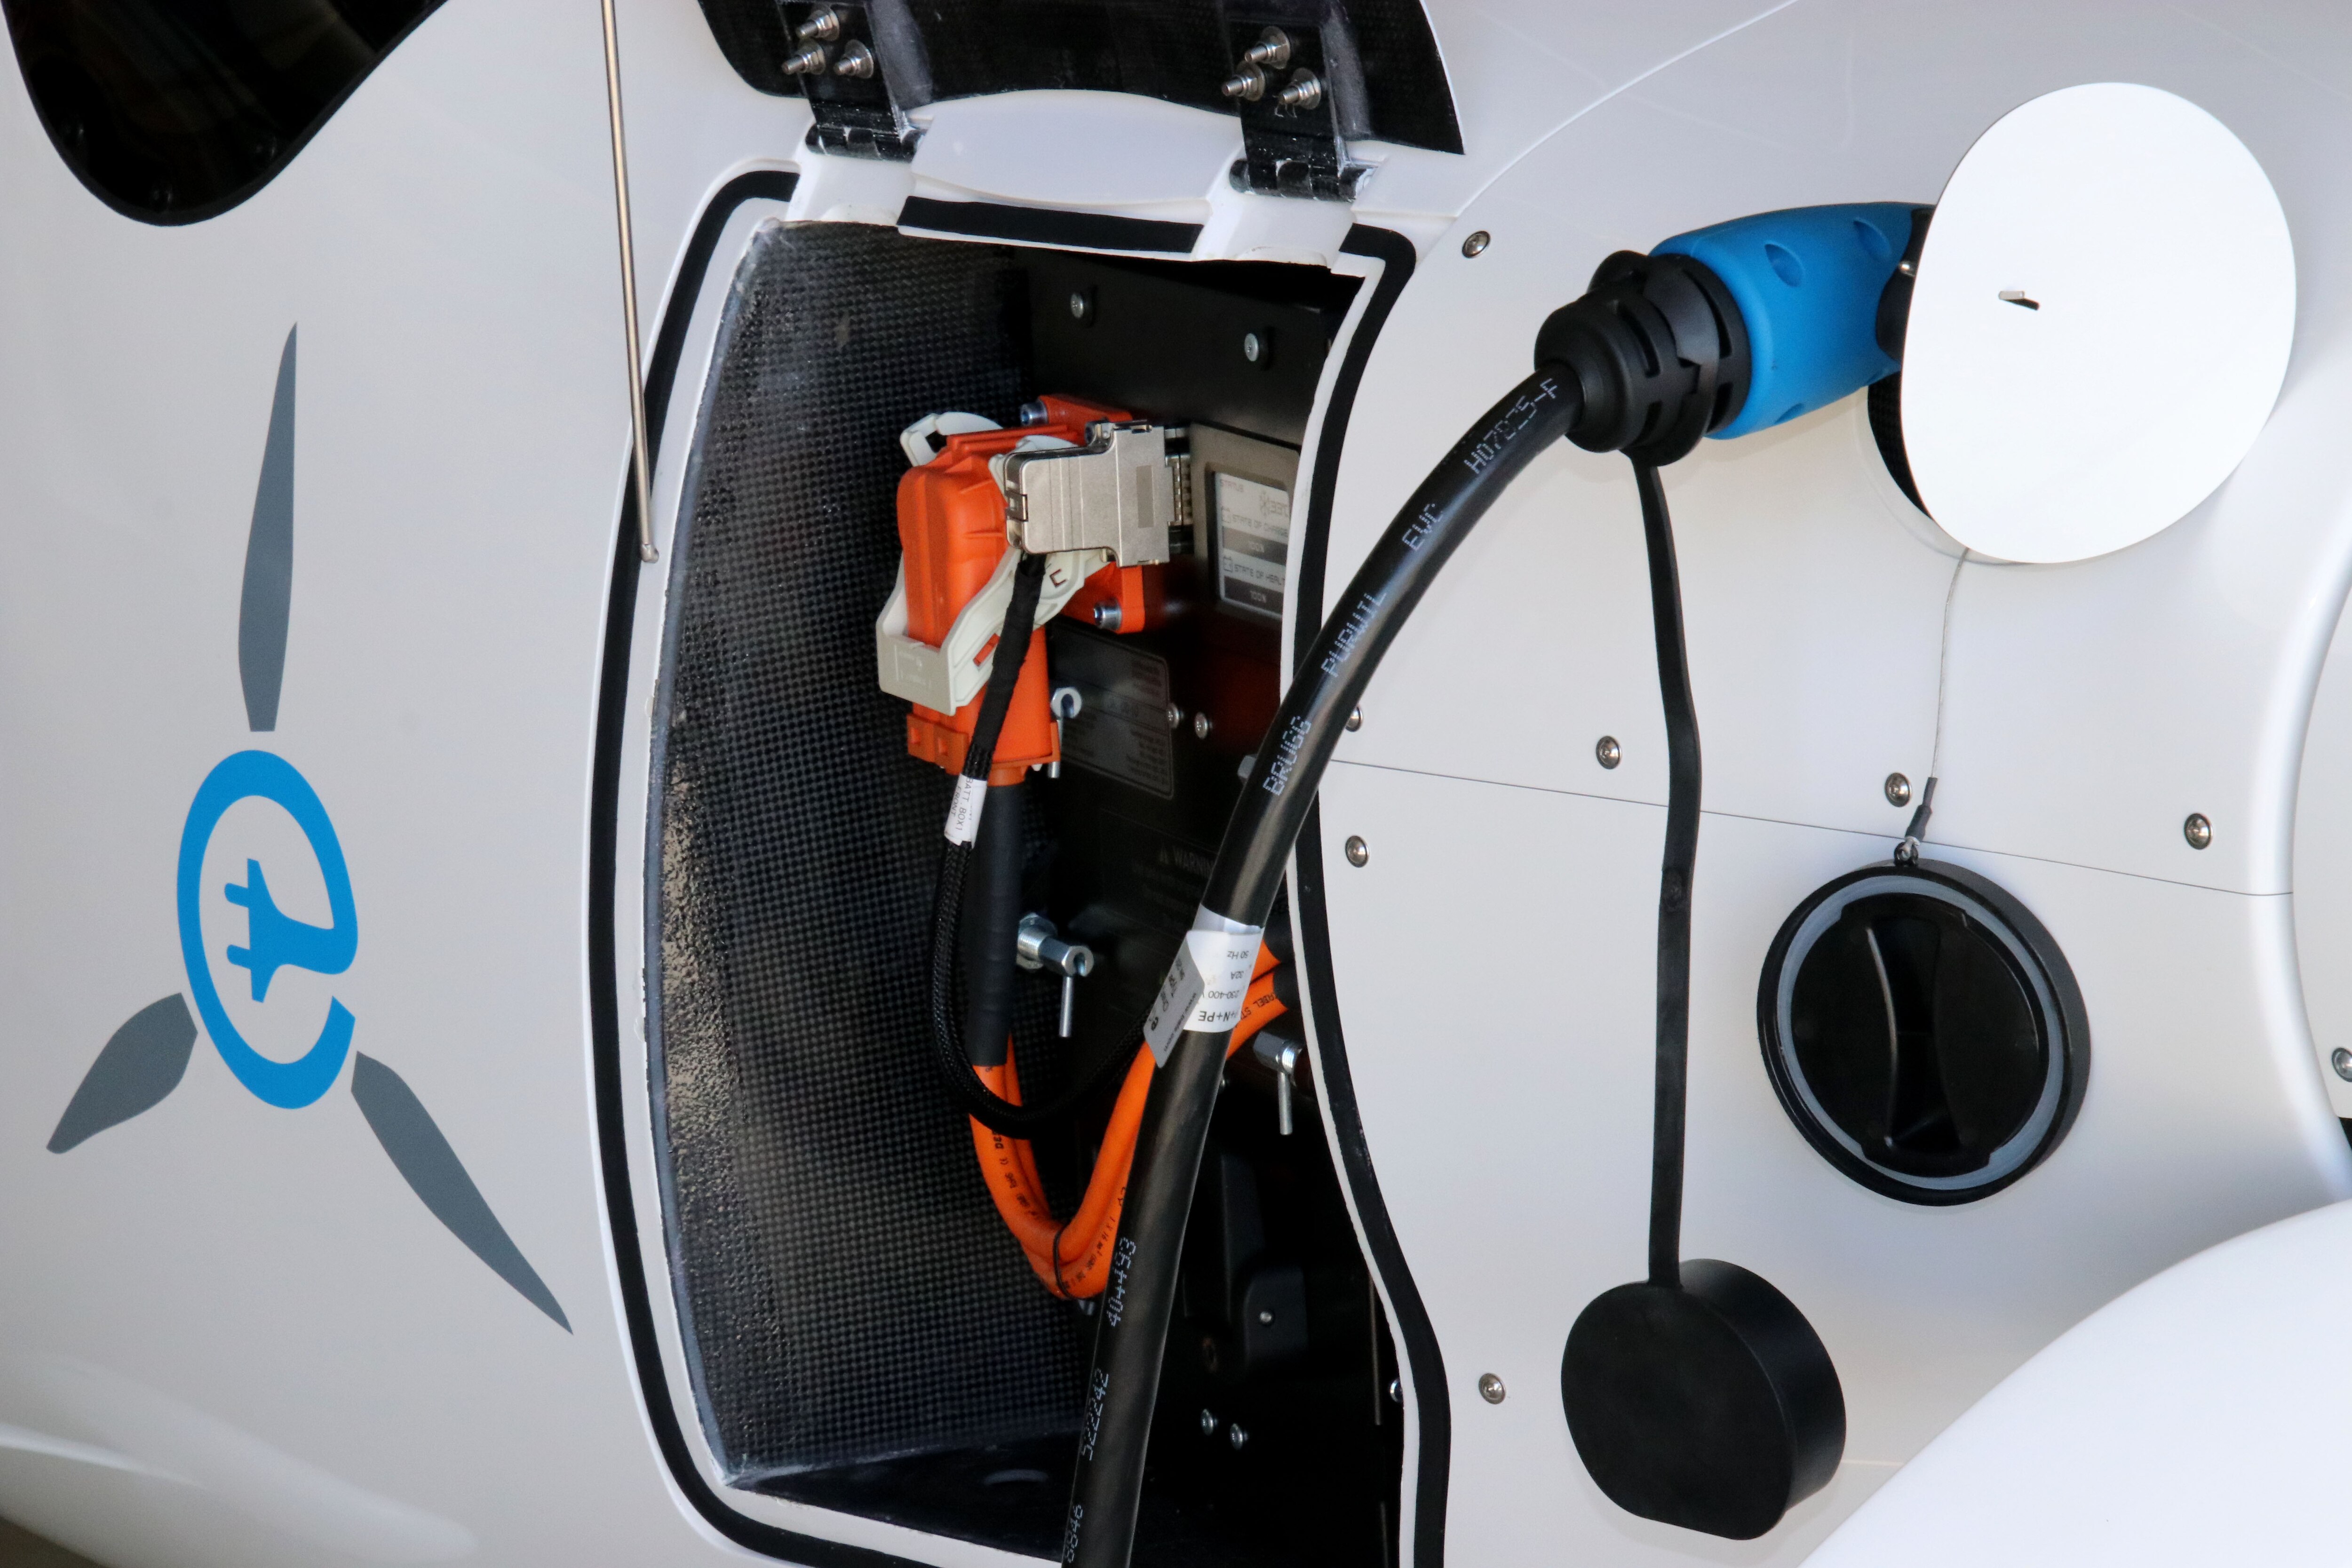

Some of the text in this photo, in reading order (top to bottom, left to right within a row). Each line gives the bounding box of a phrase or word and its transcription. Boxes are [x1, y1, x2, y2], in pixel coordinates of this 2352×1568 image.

[1262, 716, 1312, 796] BRUGG
[1227, 951, 1240, 960] Hz
[1081, 1368, 1109, 1460] 522242
